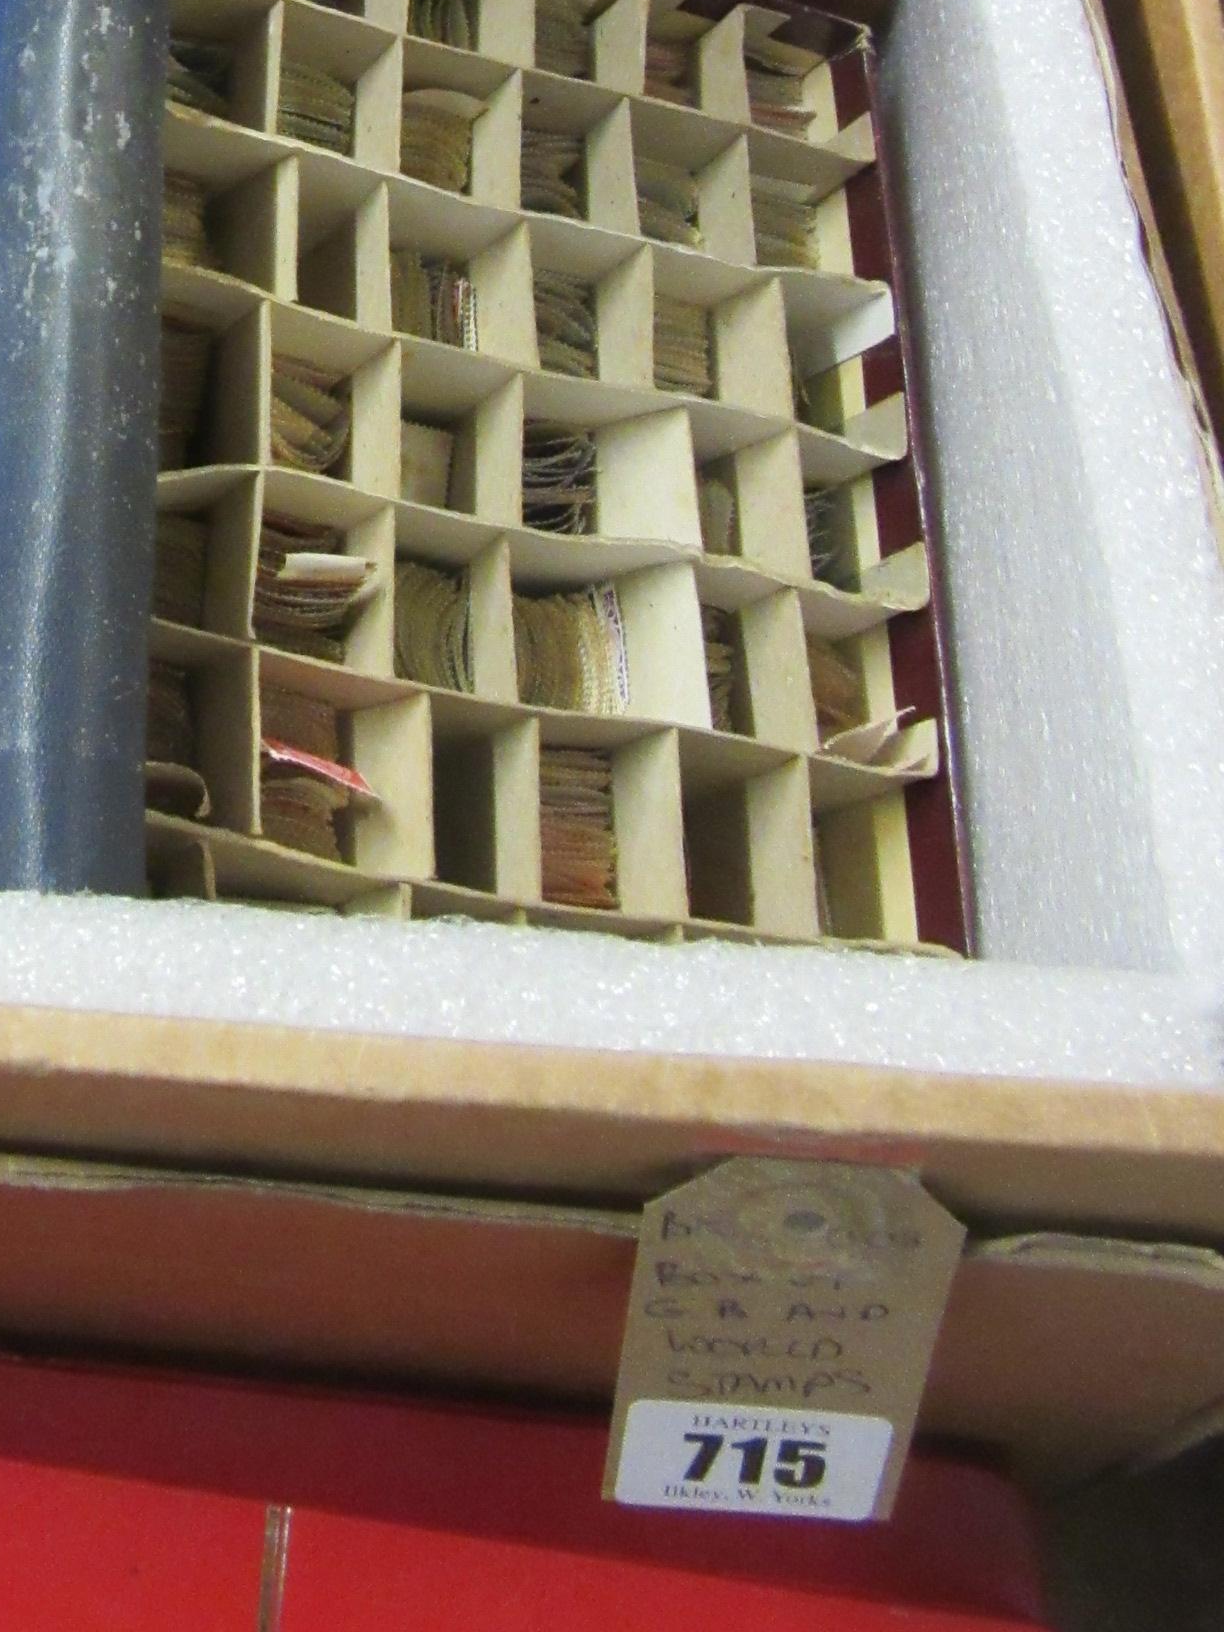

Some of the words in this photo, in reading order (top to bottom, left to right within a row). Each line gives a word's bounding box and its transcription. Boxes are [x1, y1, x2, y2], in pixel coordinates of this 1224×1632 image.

[665, 1369, 872, 1399] STAMPS
[691, 1414, 831, 1436] HARTLEYS
[683, 1432, 828, 1489] 715
